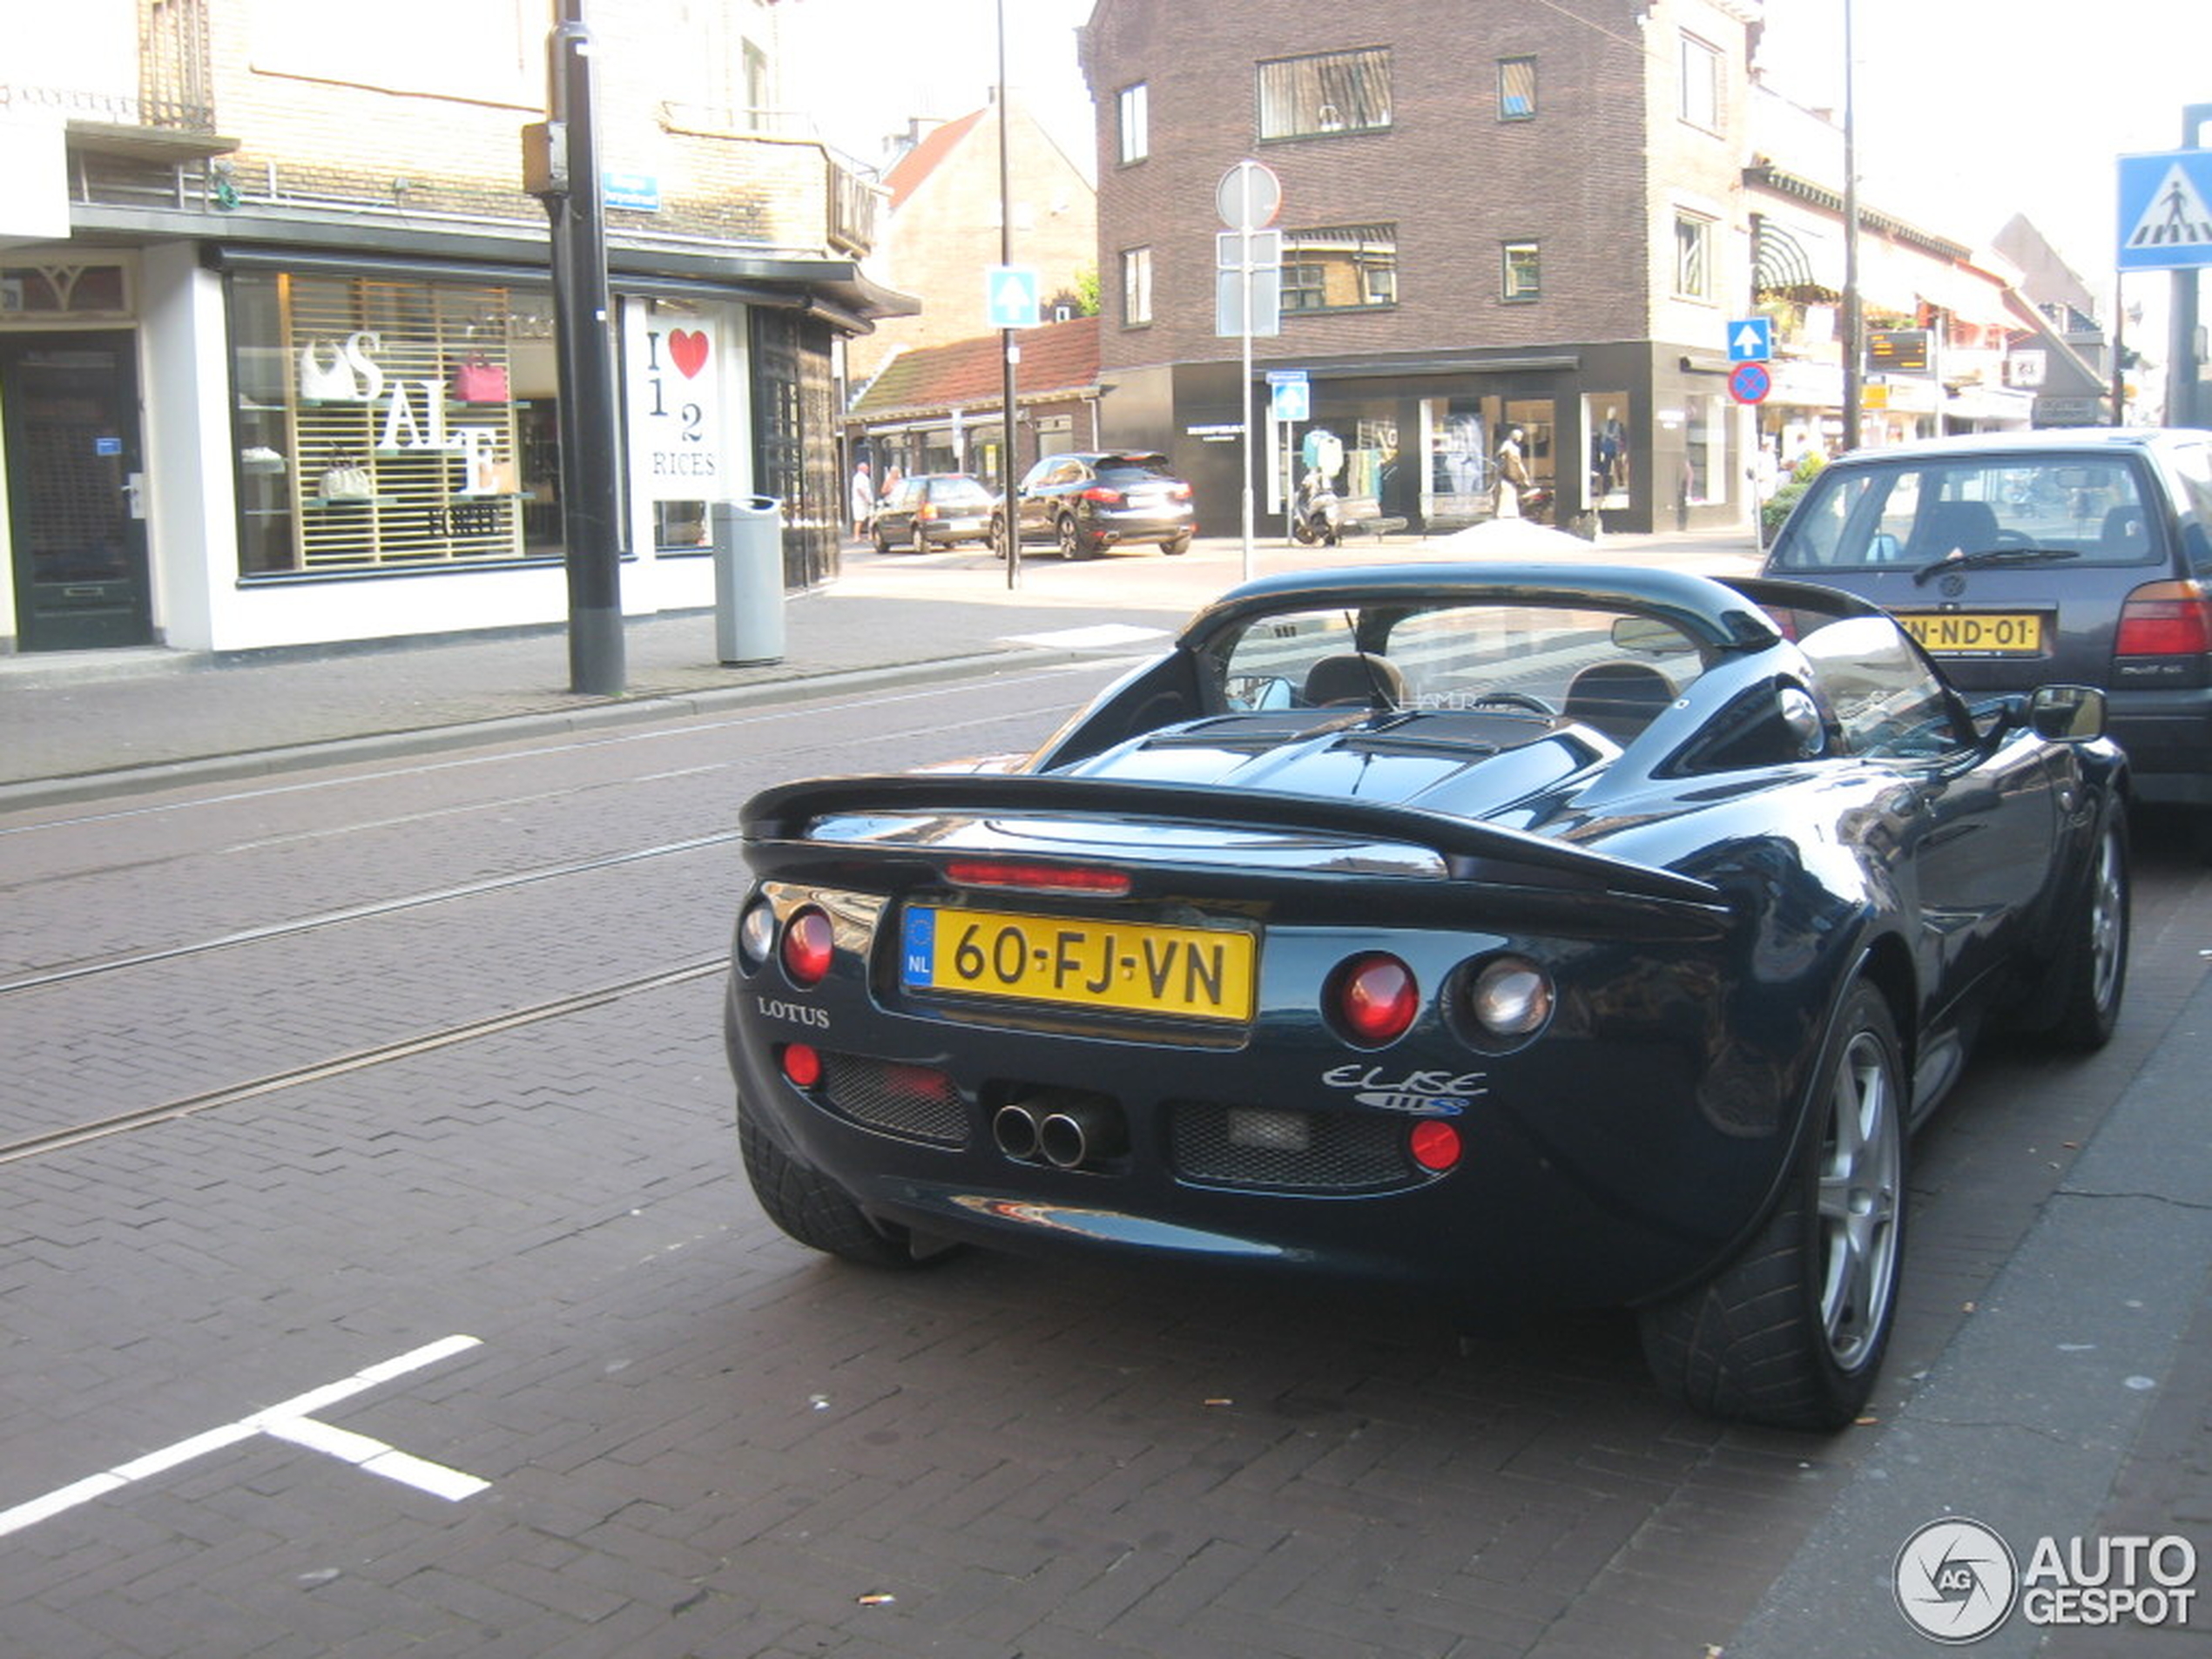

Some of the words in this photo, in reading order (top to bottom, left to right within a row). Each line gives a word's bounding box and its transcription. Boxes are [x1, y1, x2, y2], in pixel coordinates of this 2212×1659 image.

[346, 330, 499, 496] SALE
[652, 452, 715, 475] RICES
[1902, 620, 2027, 644] N-ND-01
[908, 955, 929, 973] NL
[954, 924, 1224, 1005] 60-FJ-VN
[758, 995, 830, 1028] LOTUS
[1322, 1064, 1488, 1096] ELISE
